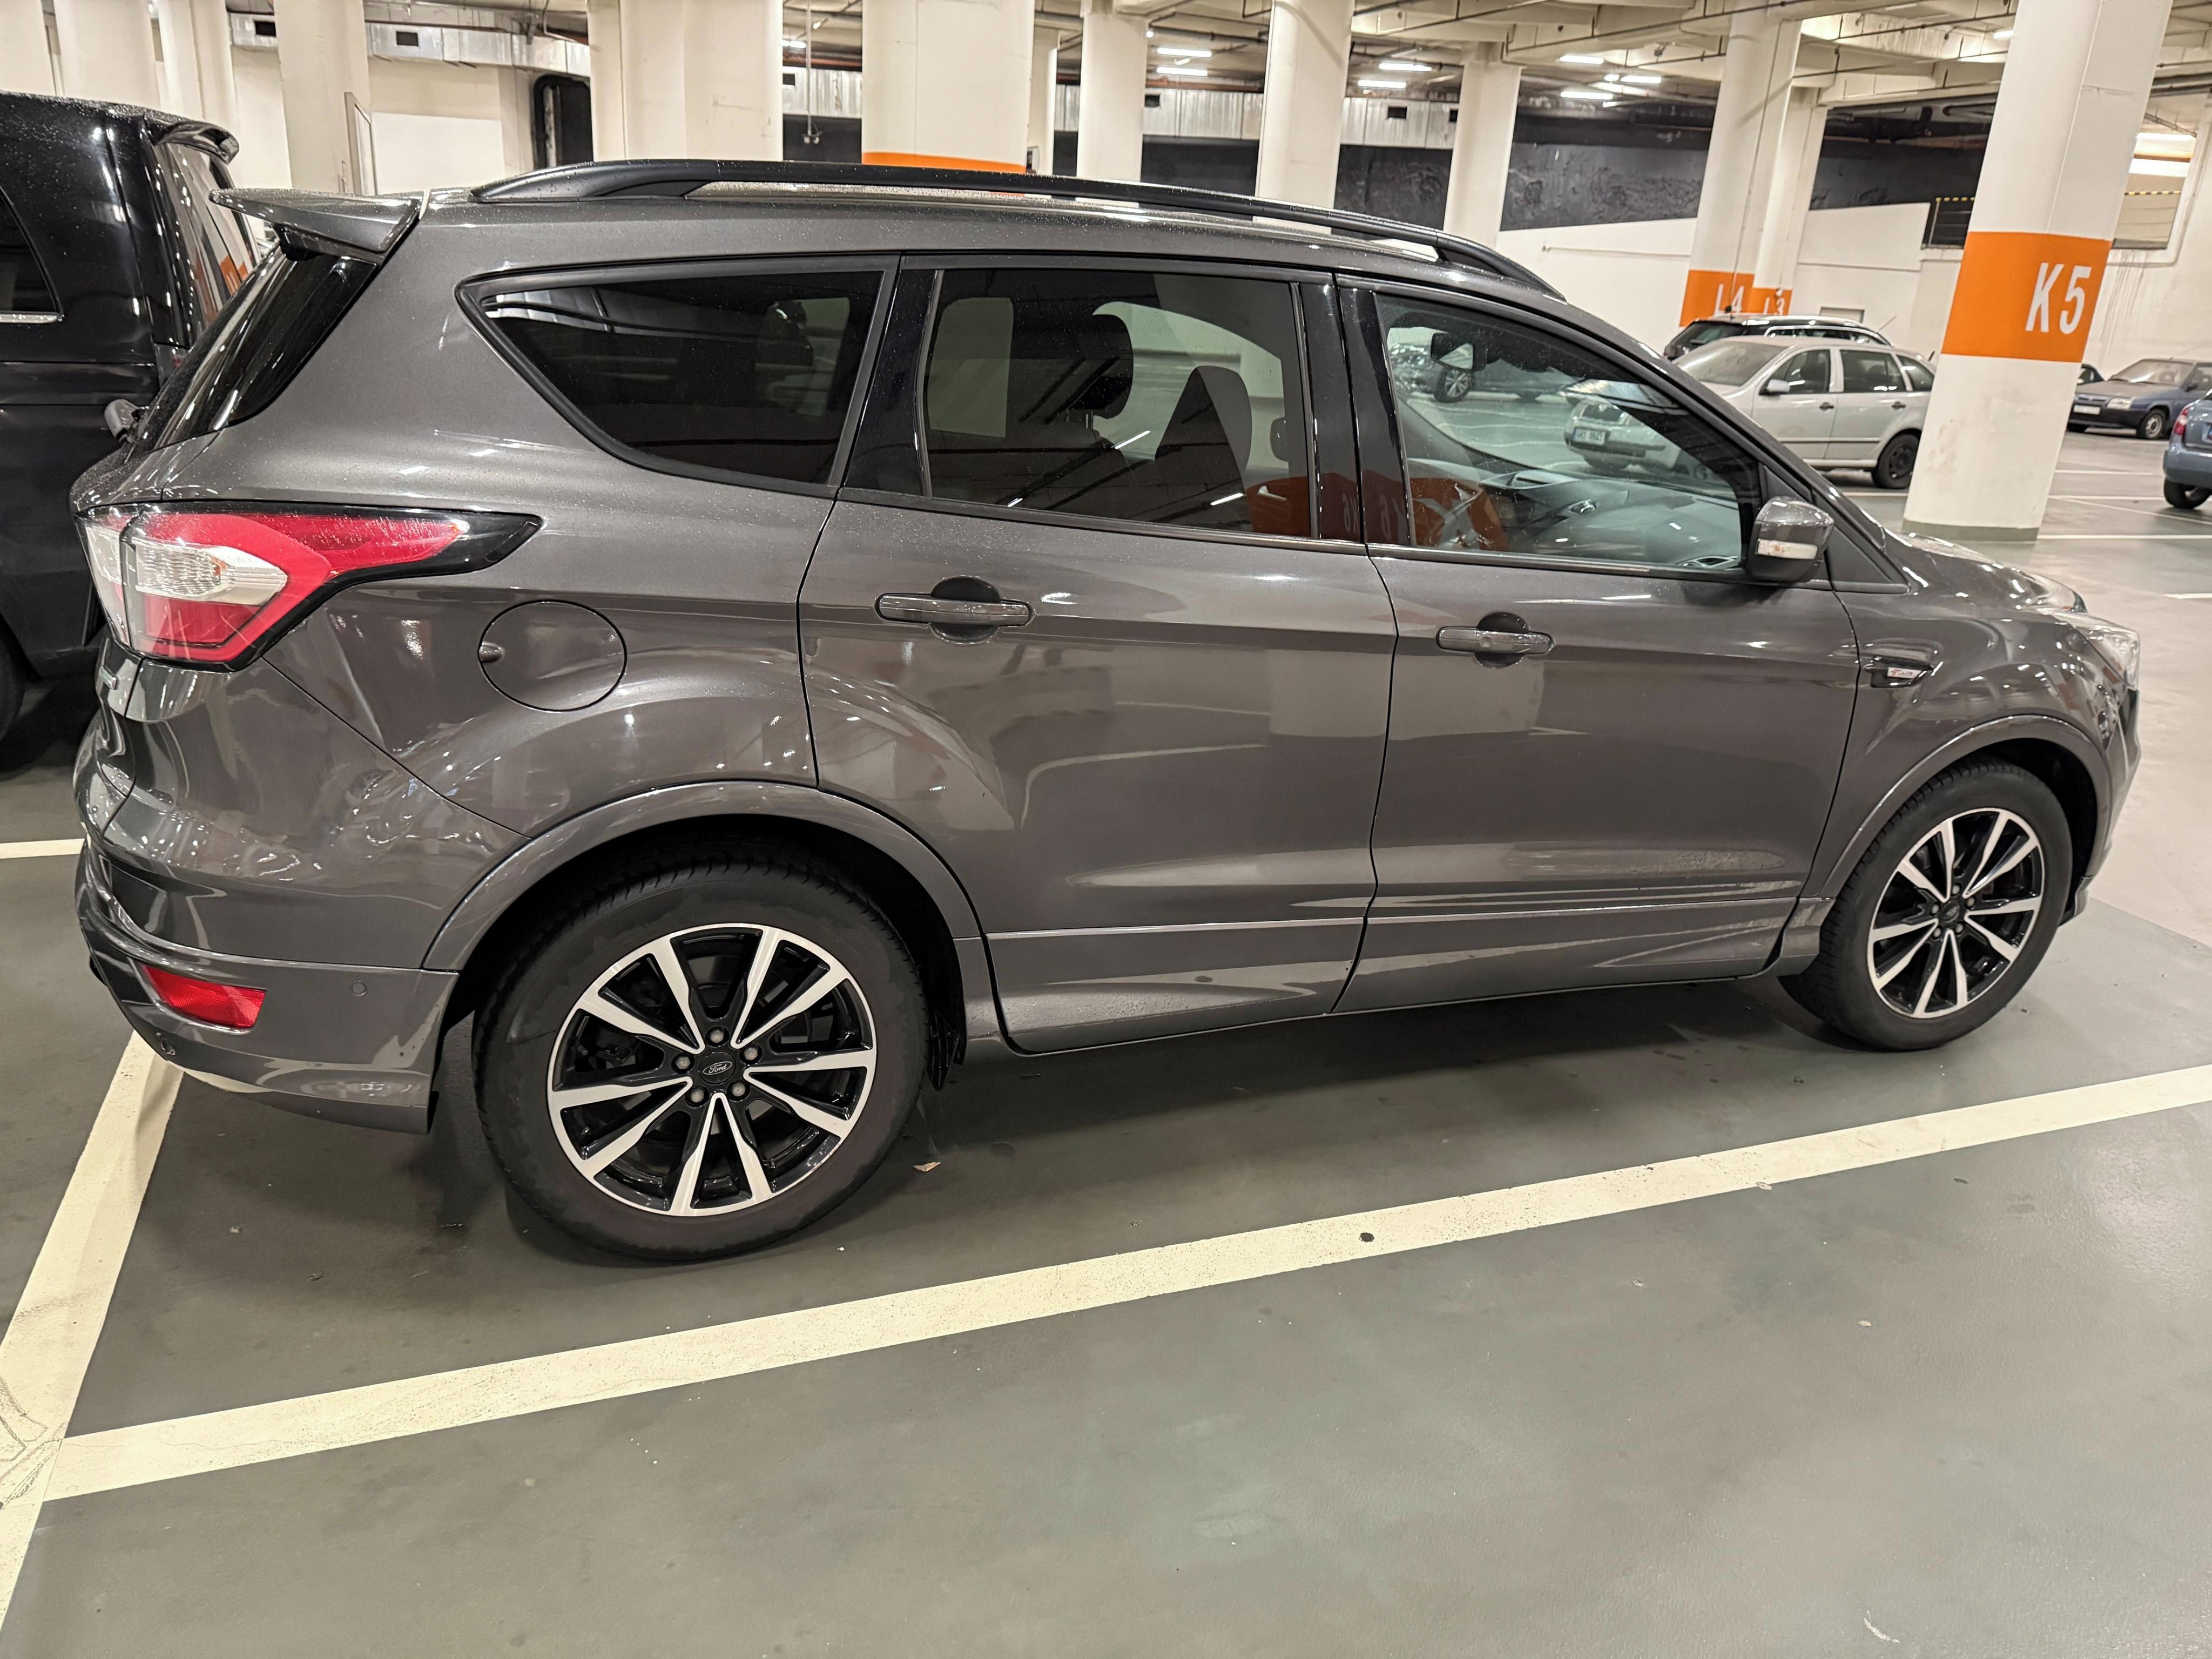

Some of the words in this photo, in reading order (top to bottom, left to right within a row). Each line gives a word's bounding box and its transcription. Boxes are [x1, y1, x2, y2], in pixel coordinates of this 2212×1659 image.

[1714, 283, 1745, 315] L4
[2025, 262, 2092, 334] K5
[709, 1063, 727, 1074] Ford
